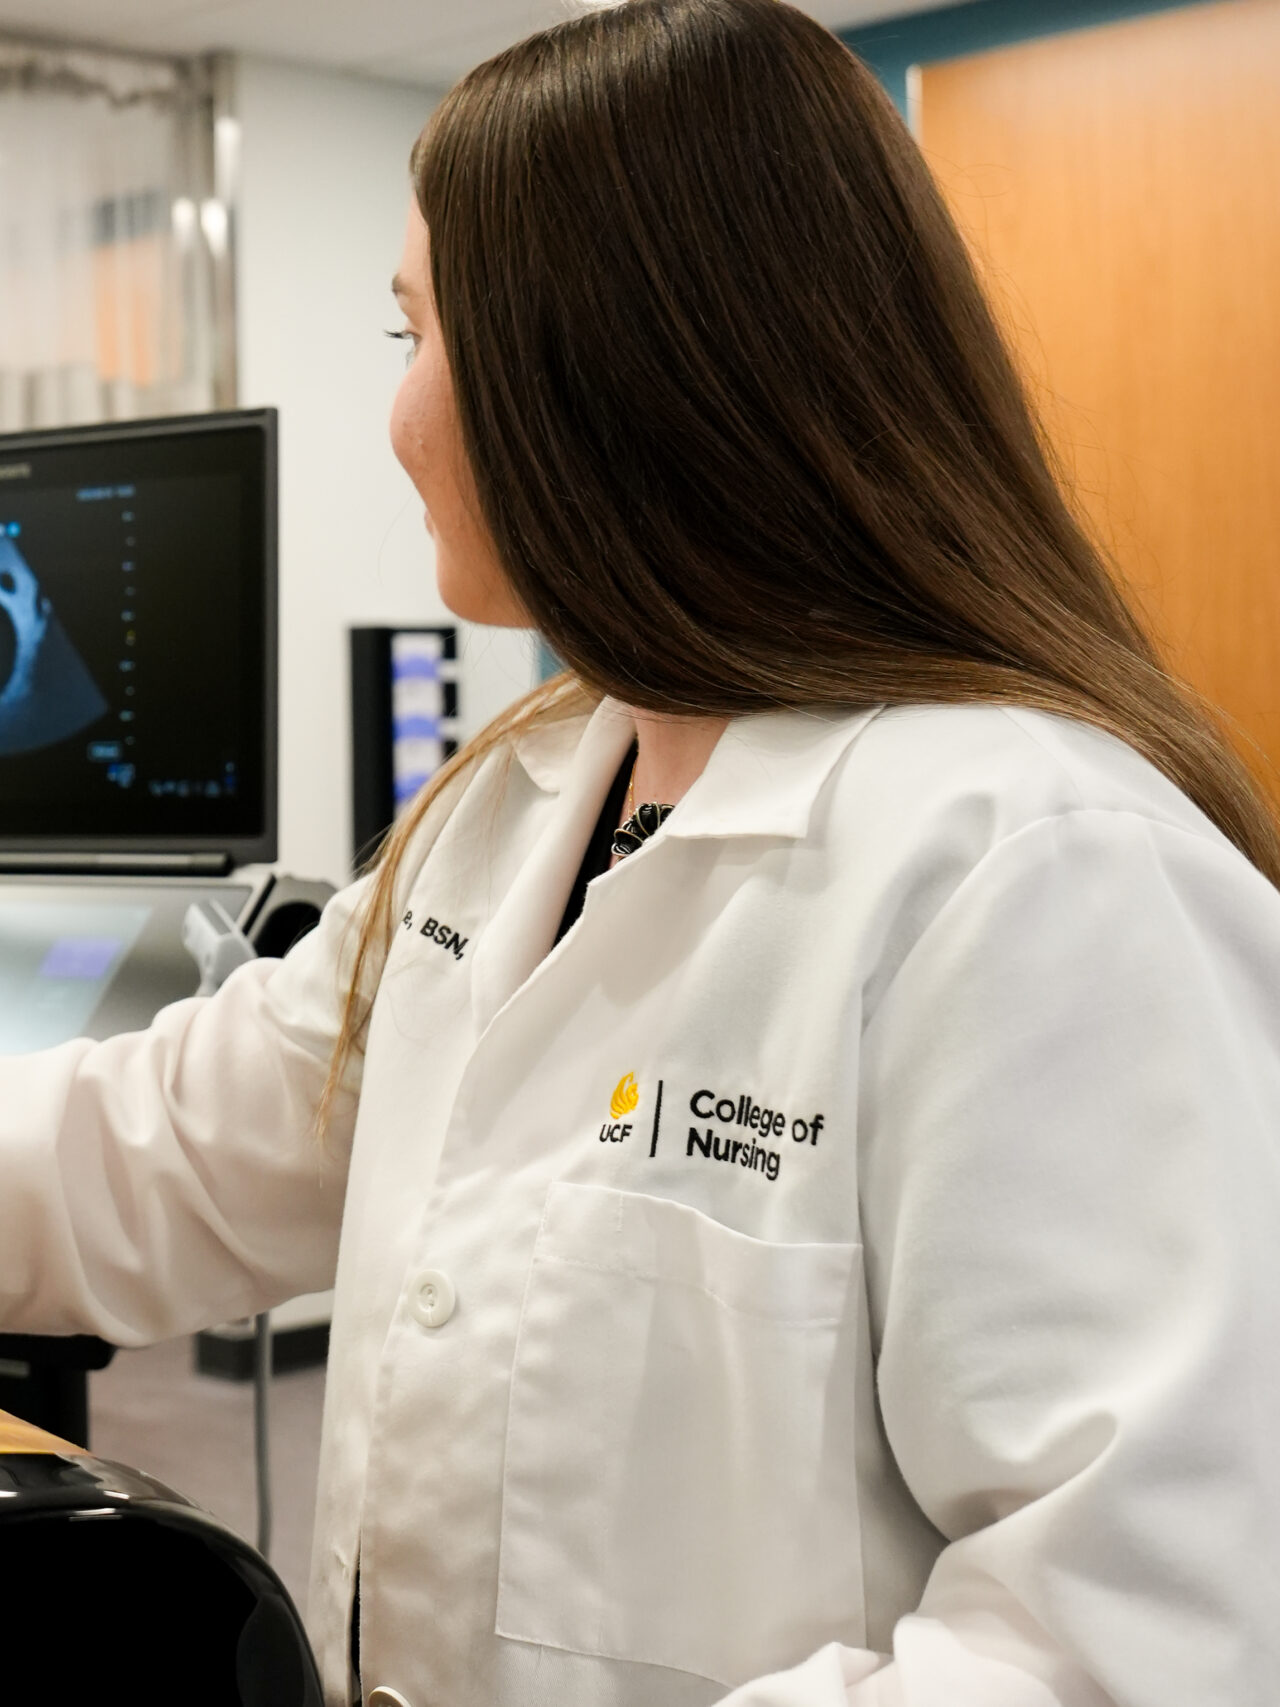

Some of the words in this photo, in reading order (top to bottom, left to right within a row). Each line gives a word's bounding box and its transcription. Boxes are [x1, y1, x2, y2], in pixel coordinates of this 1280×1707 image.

[420, 917, 469, 960] BSN,
[599, 1124, 632, 1142] UCF
[690, 1089, 785, 1137] College
[791, 1114, 824, 1145] of
[686, 1127, 780, 1180] Nursing
